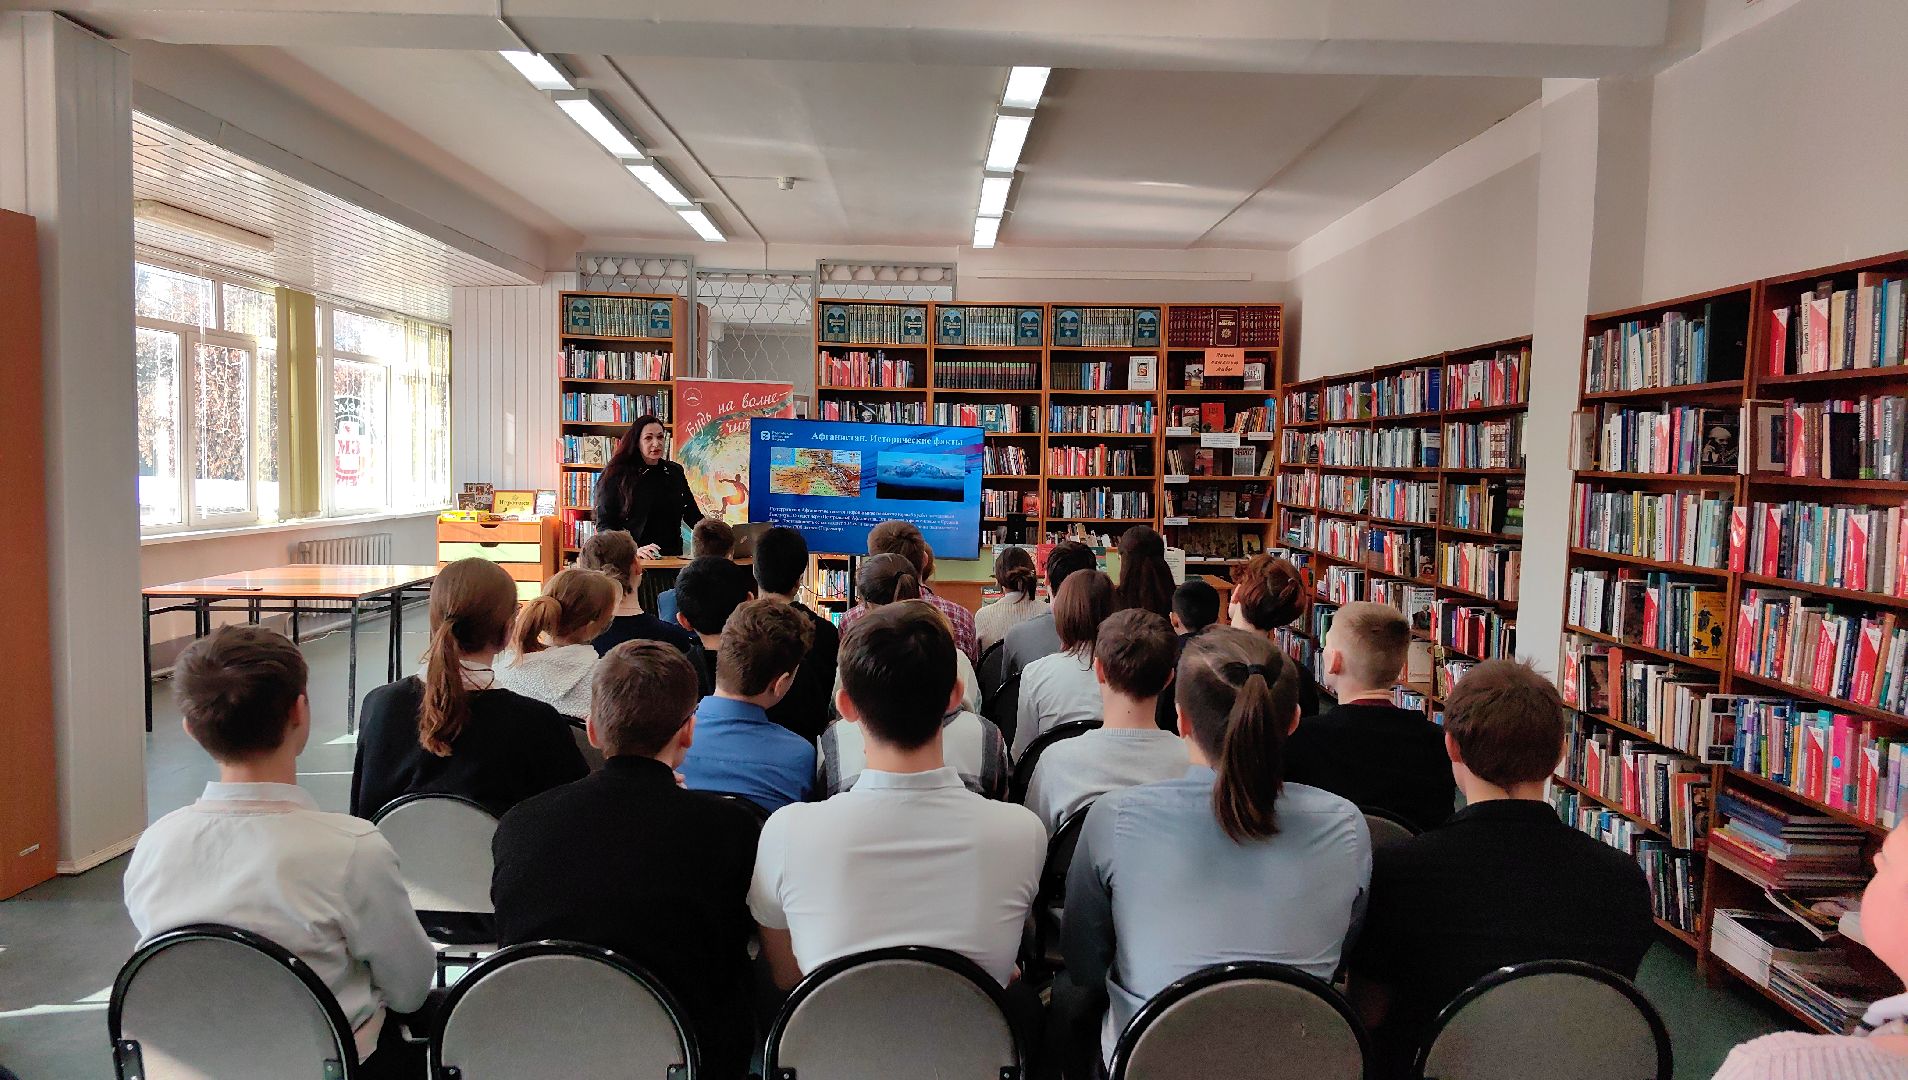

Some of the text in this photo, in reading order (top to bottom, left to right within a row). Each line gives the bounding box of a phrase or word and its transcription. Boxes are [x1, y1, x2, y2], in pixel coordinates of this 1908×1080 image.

[685, 411, 712, 439] Будь
[718, 400, 736, 415] на
[810, 432, 963, 447] Афганистан. Исторические факты
